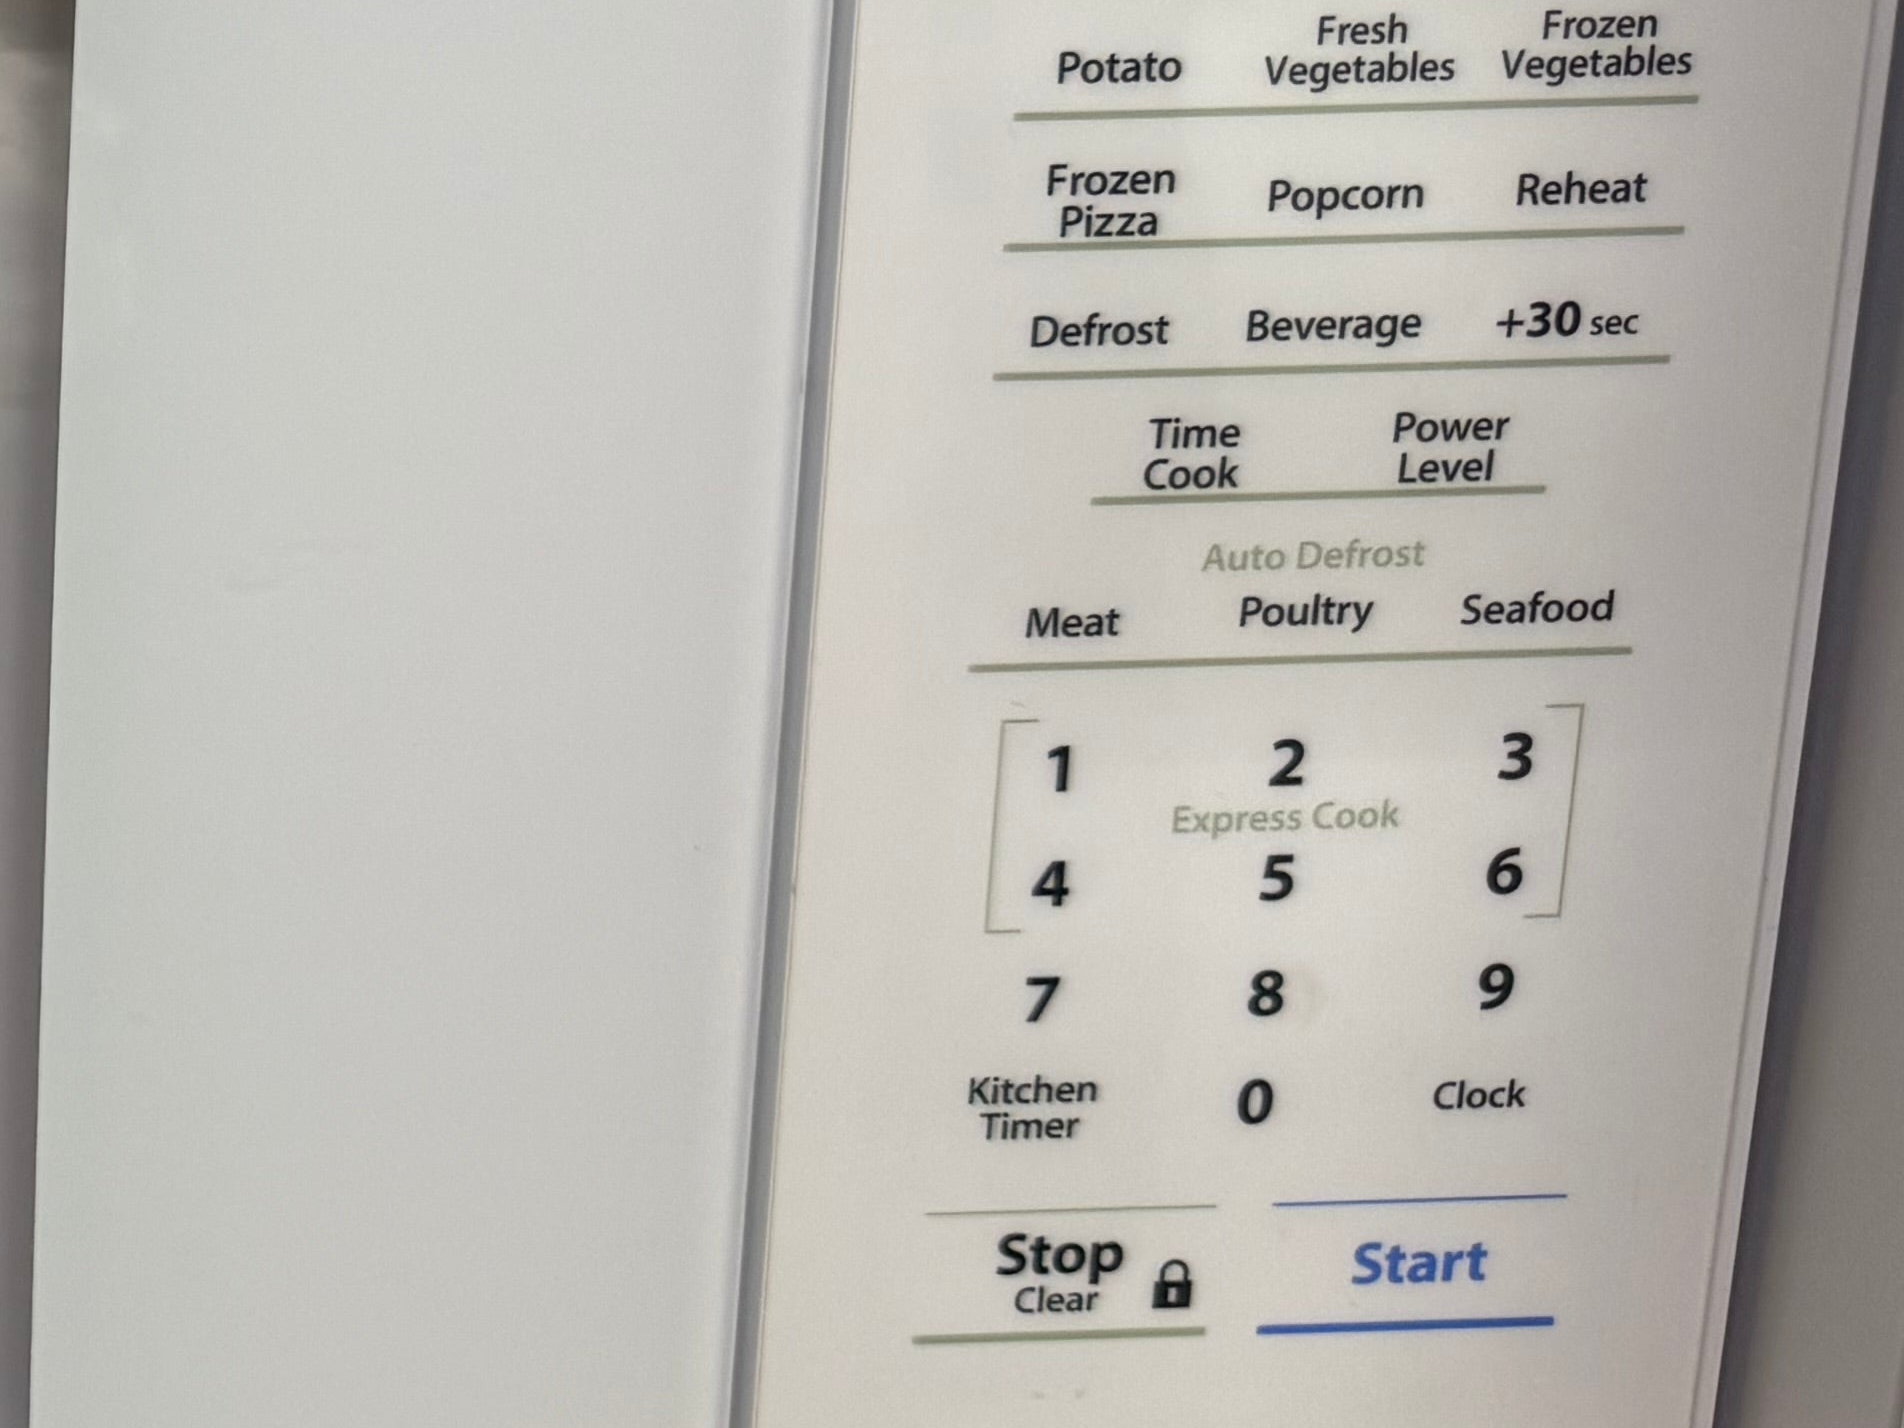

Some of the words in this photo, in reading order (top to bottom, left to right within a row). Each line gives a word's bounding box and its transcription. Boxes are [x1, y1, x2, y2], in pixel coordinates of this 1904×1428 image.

[1317, 12, 1409, 46] Fresh
[1542, 9, 1659, 40] Frozen
[1057, 50, 1183, 85] Potato
[1264, 49, 1456, 94] Vegetables
[1502, 43, 1693, 84] Vegetables
[1046, 163, 1177, 197] Frozen
[1268, 178, 1425, 219] Popcorn
[1516, 170, 1649, 206] Reheat
[1059, 204, 1159, 239] Pizza
[1030, 311, 1171, 349] Defrost
[1246, 308, 1423, 349] Beverage
[1496, 300, 1583, 338] +30
[1589, 313, 1640, 336] sec
[1149, 416, 1242, 450] Time
[1392, 411, 1511, 444] Power
[1143, 455, 1239, 492] Cook
[1397, 448, 1496, 485] Level
[1201, 543, 1288, 573] Auto
[1296, 537, 1427, 571] Defrost
[1025, 606, 1122, 639] Meat
[1239, 592, 1375, 634] Poultry
[1460, 588, 1616, 626] Seafood
[1048, 744, 1072, 793] 1
[1268, 738, 1306, 787] 2
[1497, 731, 1534, 781] 3
[1171, 804, 1303, 841] Express
[1311, 798, 1400, 831] Cook
[1031, 860, 1071, 908] 4
[1259, 853, 1295, 902] 5
[1486, 846, 1524, 896] 6
[1026, 975, 1062, 1023] 7
[1247, 969, 1285, 1018] 8
[1478, 962, 1516, 1011] 9
[967, 1074, 1099, 1106] Kitchen
[1237, 1078, 1275, 1126] 0
[1433, 1078, 1526, 1111] Clock
[979, 1111, 1081, 1141] Timer
[996, 1232, 1125, 1285] Stop
[1352, 1241, 1489, 1286] Start
[1014, 1281, 1101, 1315] Clear
